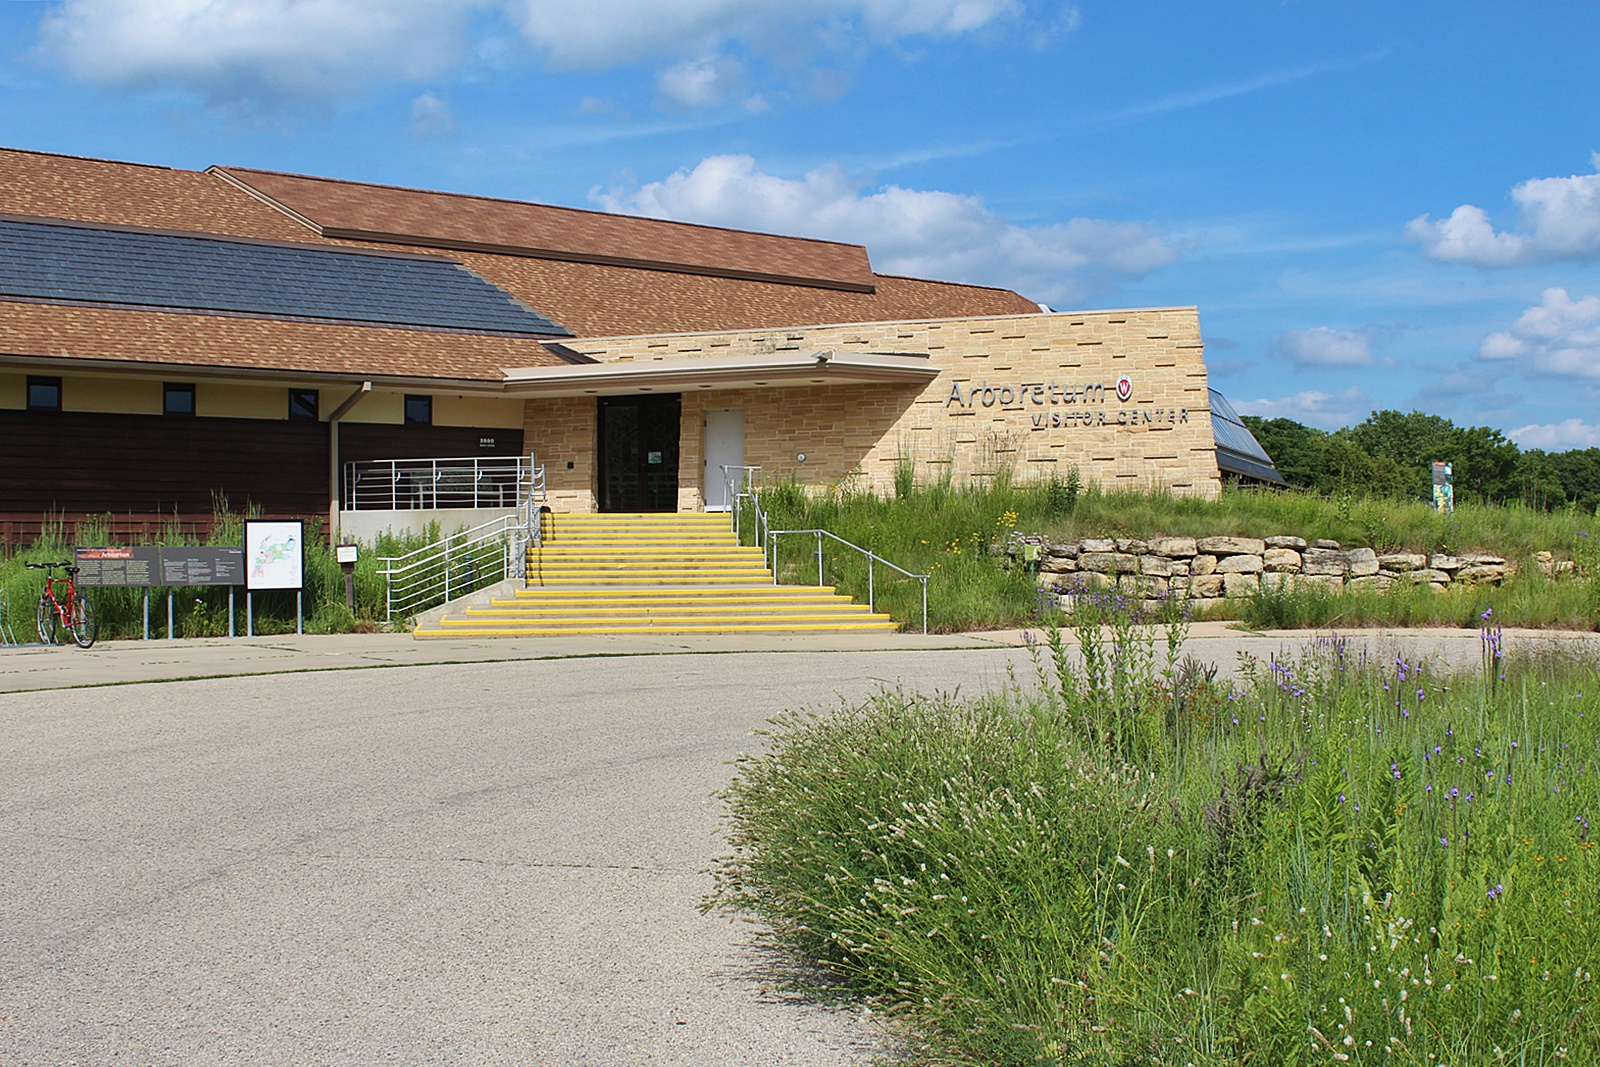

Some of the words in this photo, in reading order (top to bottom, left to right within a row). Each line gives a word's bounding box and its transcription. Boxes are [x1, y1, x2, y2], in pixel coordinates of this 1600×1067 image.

[946, 380, 1104, 408] Arboretum
[1032, 410, 1106, 428] VISITOR
[1117, 408, 1189, 426] CENTER
